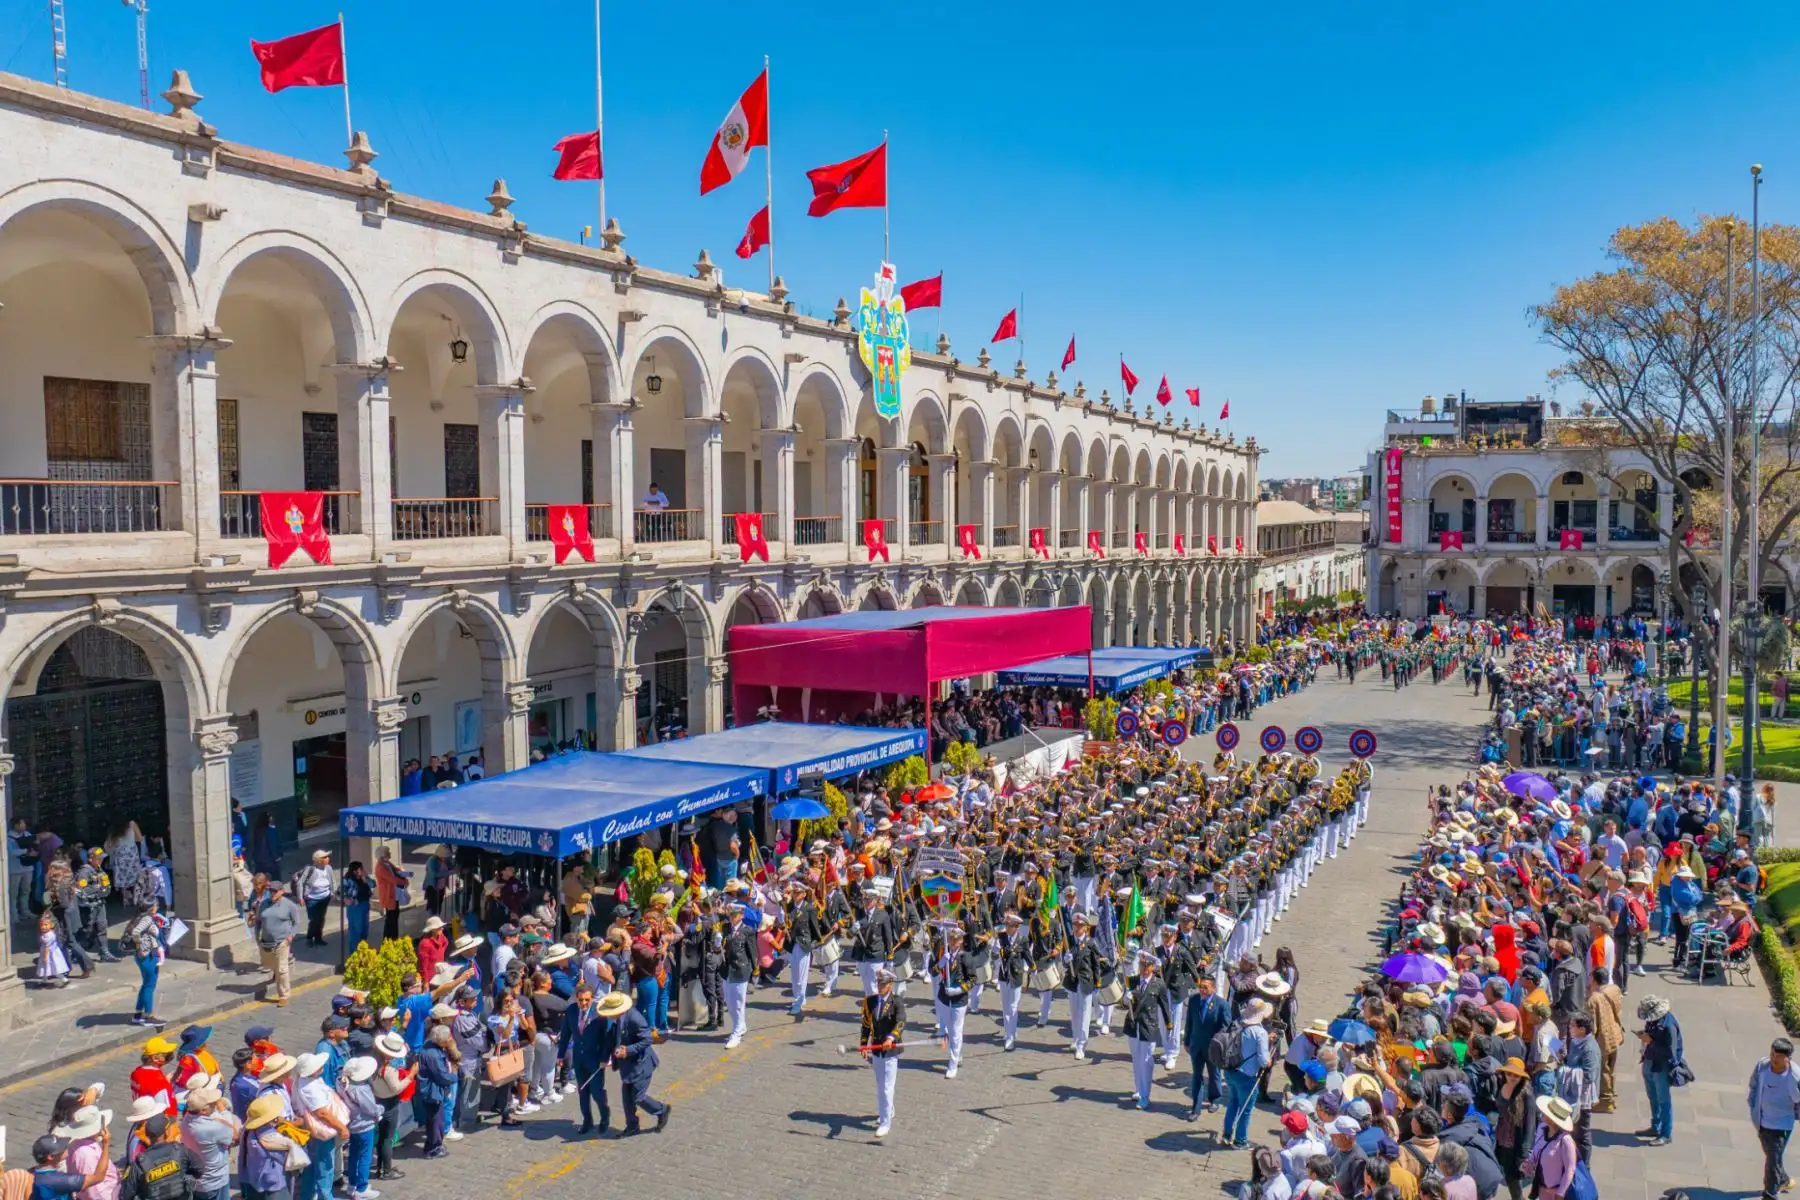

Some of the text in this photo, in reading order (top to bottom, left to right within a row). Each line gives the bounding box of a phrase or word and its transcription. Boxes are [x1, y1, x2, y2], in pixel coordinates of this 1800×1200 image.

[846, 750, 879, 768] PROVINCIAL
[880, 746, 888, 758] DE
[888, 738, 915, 757] AREQUIPA
[364, 815, 532, 848] MUNICIPALIDAD PROVINCIAL DE AREQUIPA
[602, 812, 652, 842] Ciudad
[655, 810, 673, 823] con
